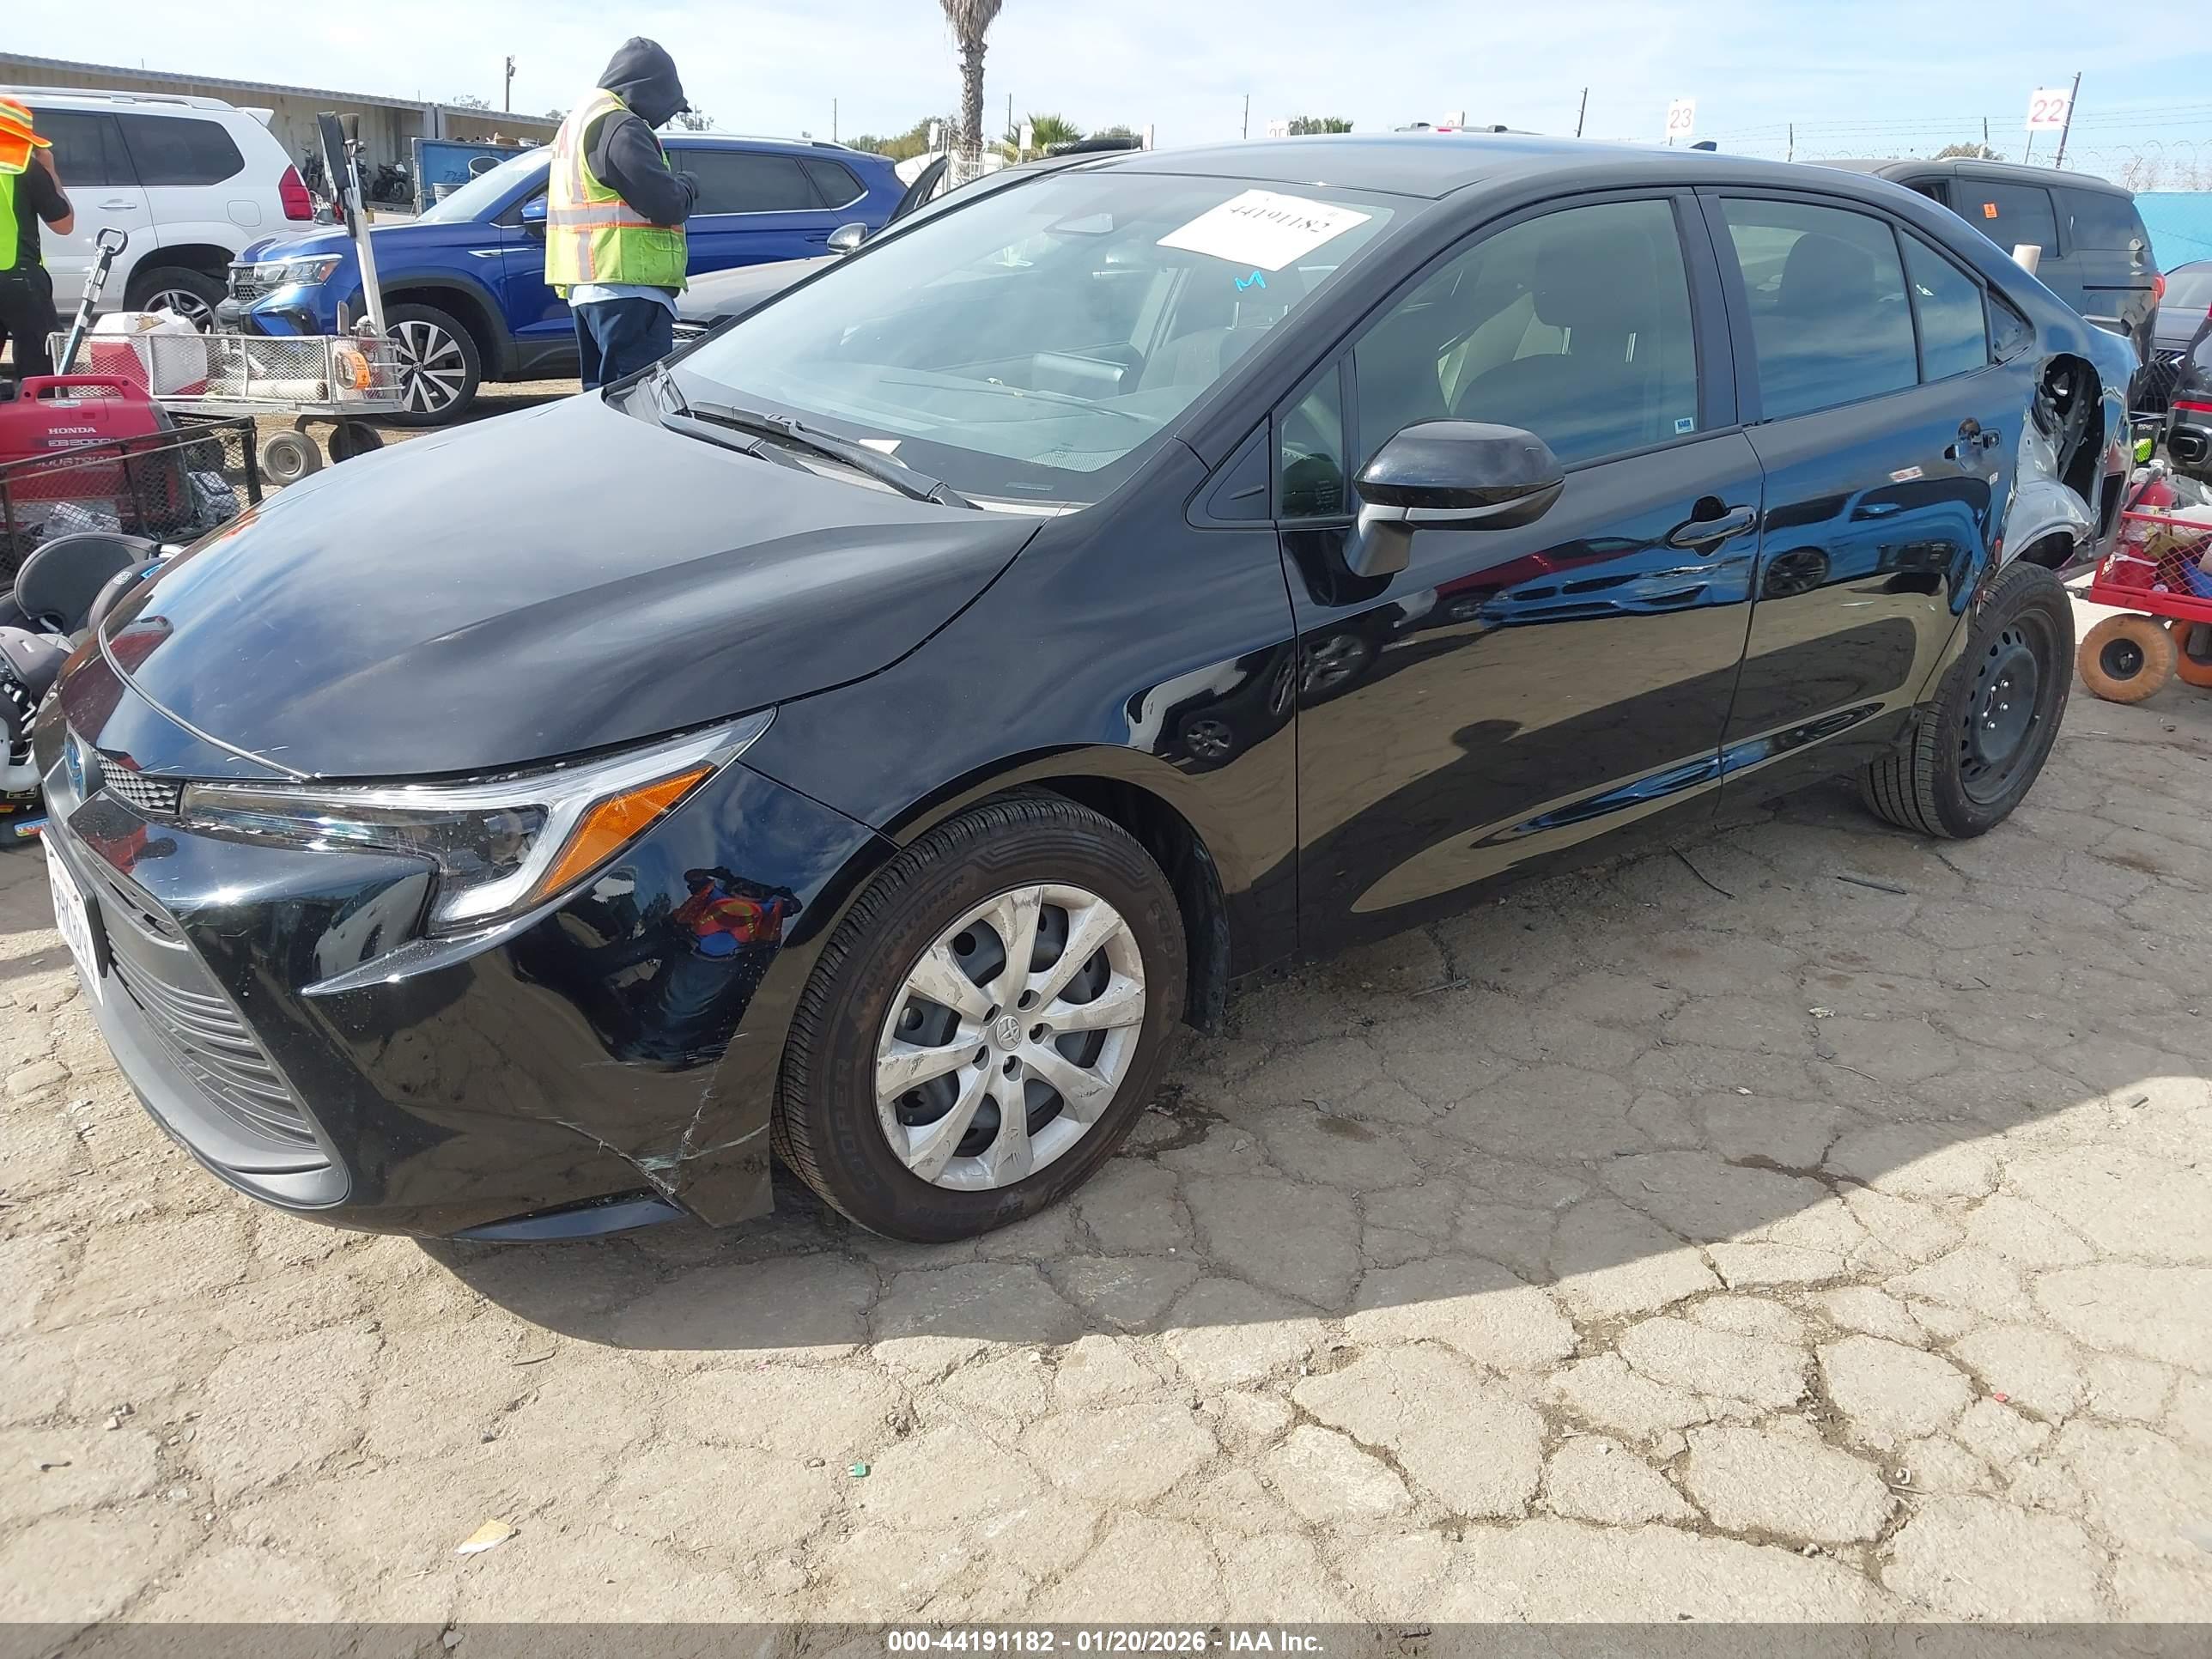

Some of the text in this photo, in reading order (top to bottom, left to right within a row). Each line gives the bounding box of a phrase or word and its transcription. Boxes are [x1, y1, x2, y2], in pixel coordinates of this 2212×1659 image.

[1670, 108, 1692, 129] 23
[2031, 98, 2064, 123] 22
[1235, 270, 1267, 292] M
